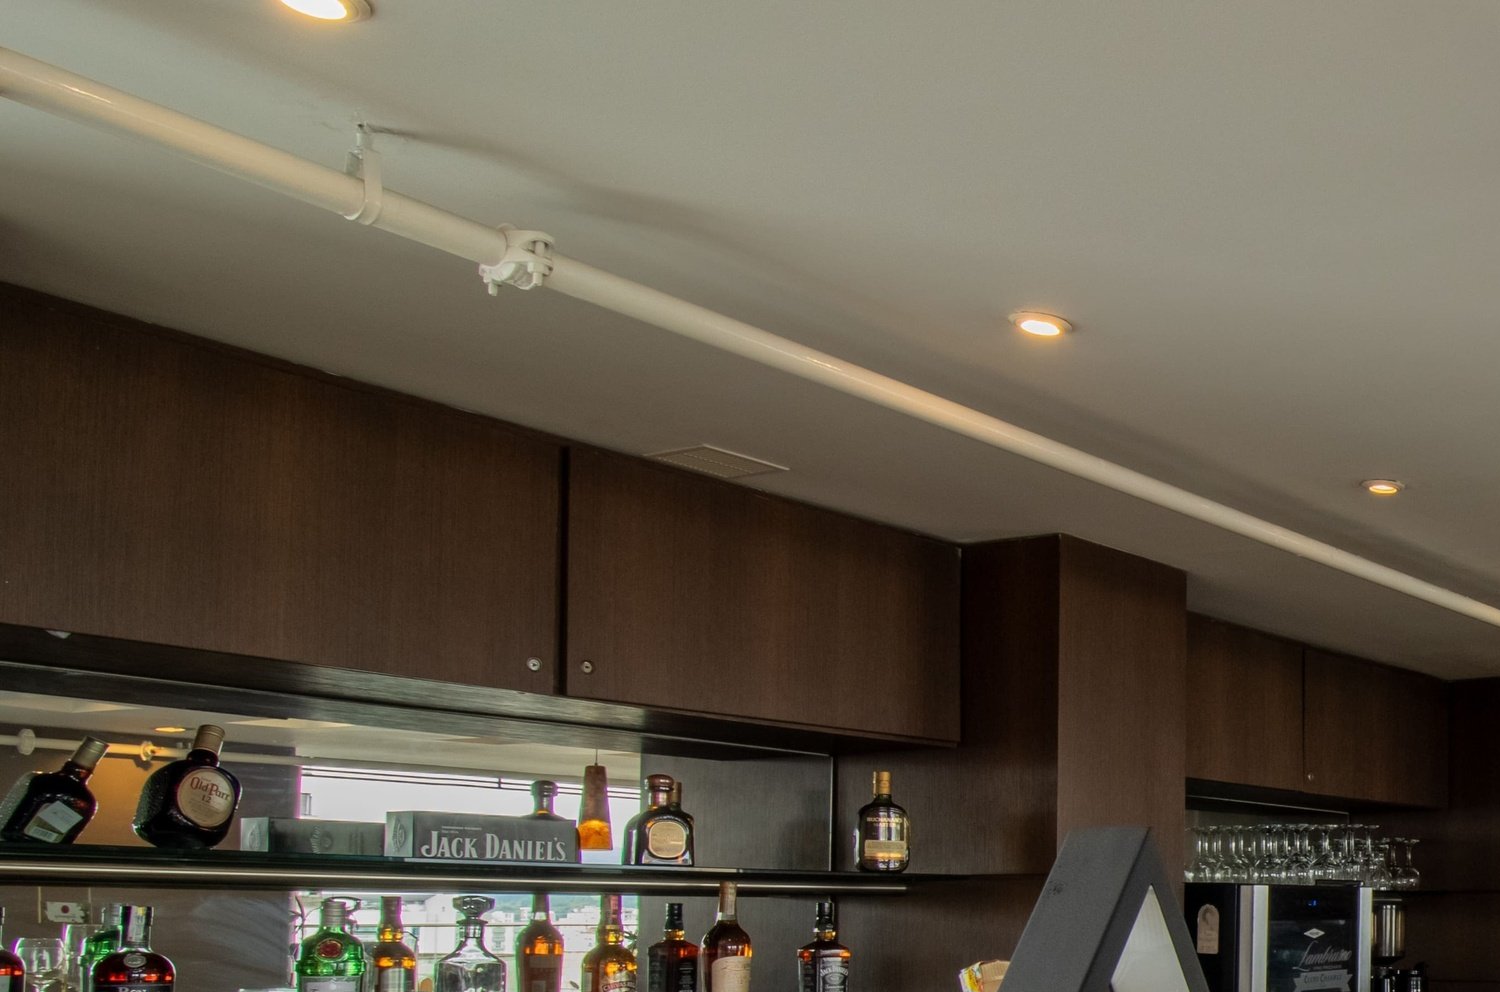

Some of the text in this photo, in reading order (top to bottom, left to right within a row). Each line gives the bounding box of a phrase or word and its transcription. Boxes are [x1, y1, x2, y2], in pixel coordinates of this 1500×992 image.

[190, 776, 230, 800] Old Parr
[202, 795, 212, 803] 12
[421, 831, 567, 862] JACK DANIEL'S
